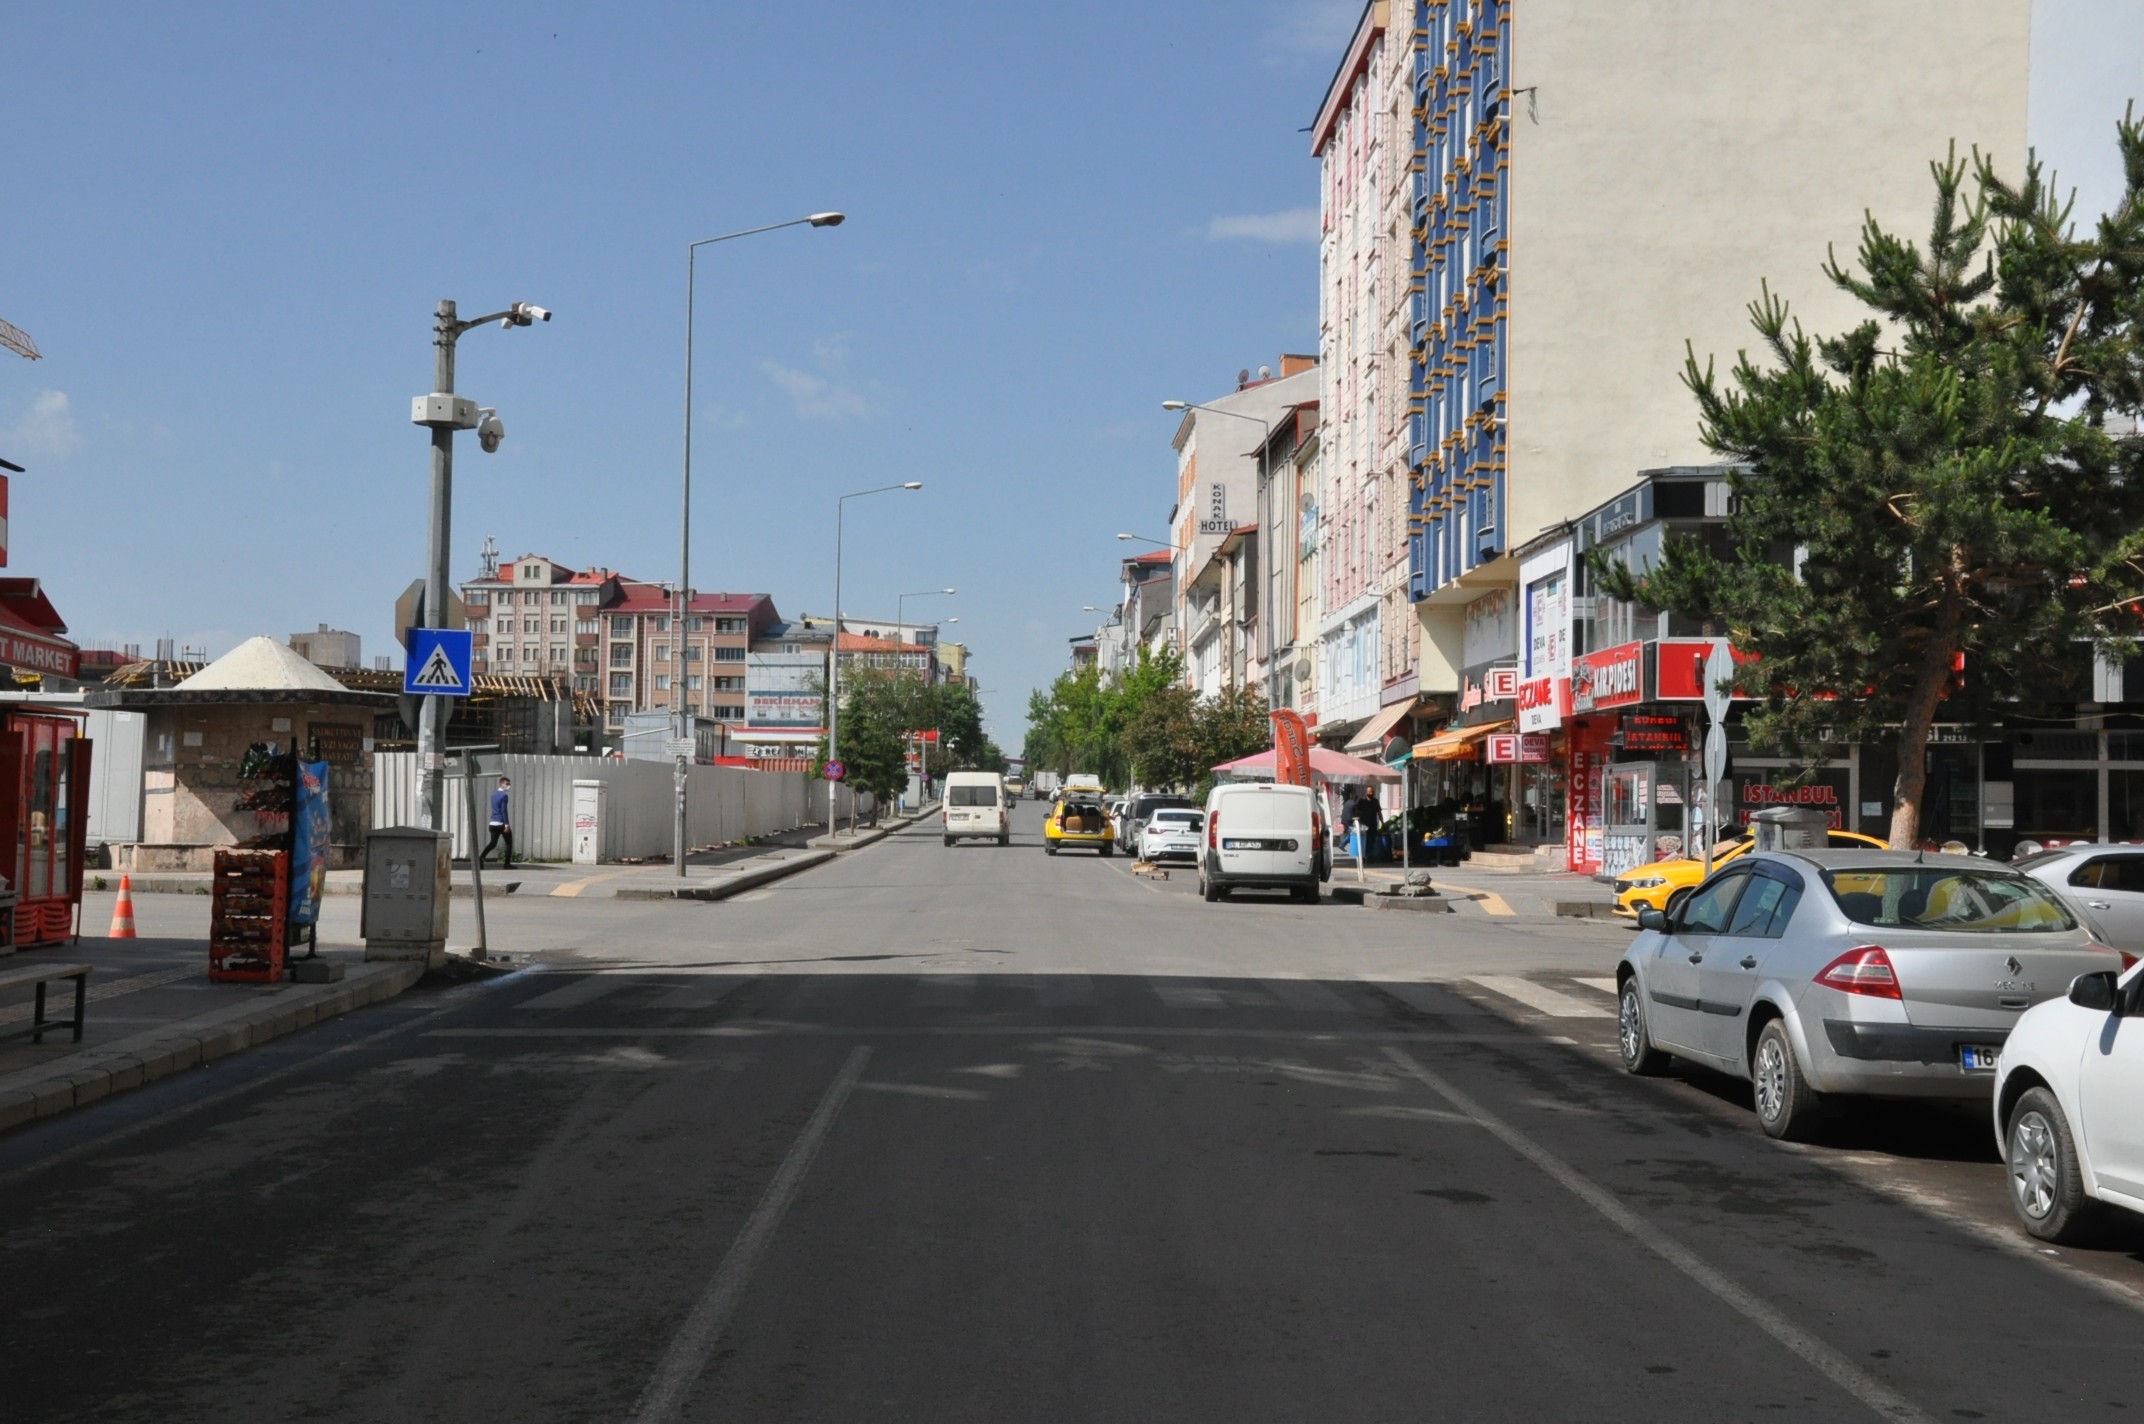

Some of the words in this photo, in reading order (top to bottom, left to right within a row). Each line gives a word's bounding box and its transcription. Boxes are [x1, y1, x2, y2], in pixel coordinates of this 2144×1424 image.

[1212, 484, 1222, 519] KONAK
[1201, 521, 1234, 532] HOTEL
[13, 641, 72, 673] MARKET
[1498, 675, 1512, 692] E
[1519, 677, 1552, 711] ECZANE
[1594, 666, 1609, 698] KIR
[1531, 714, 1542, 725] DEVA
[1496, 739, 1512, 759] E
[1524, 738, 1545, 746] DEVA
[1743, 779, 1837, 804] İSTANBUL
[1573, 752, 1585, 864] ECZANE
